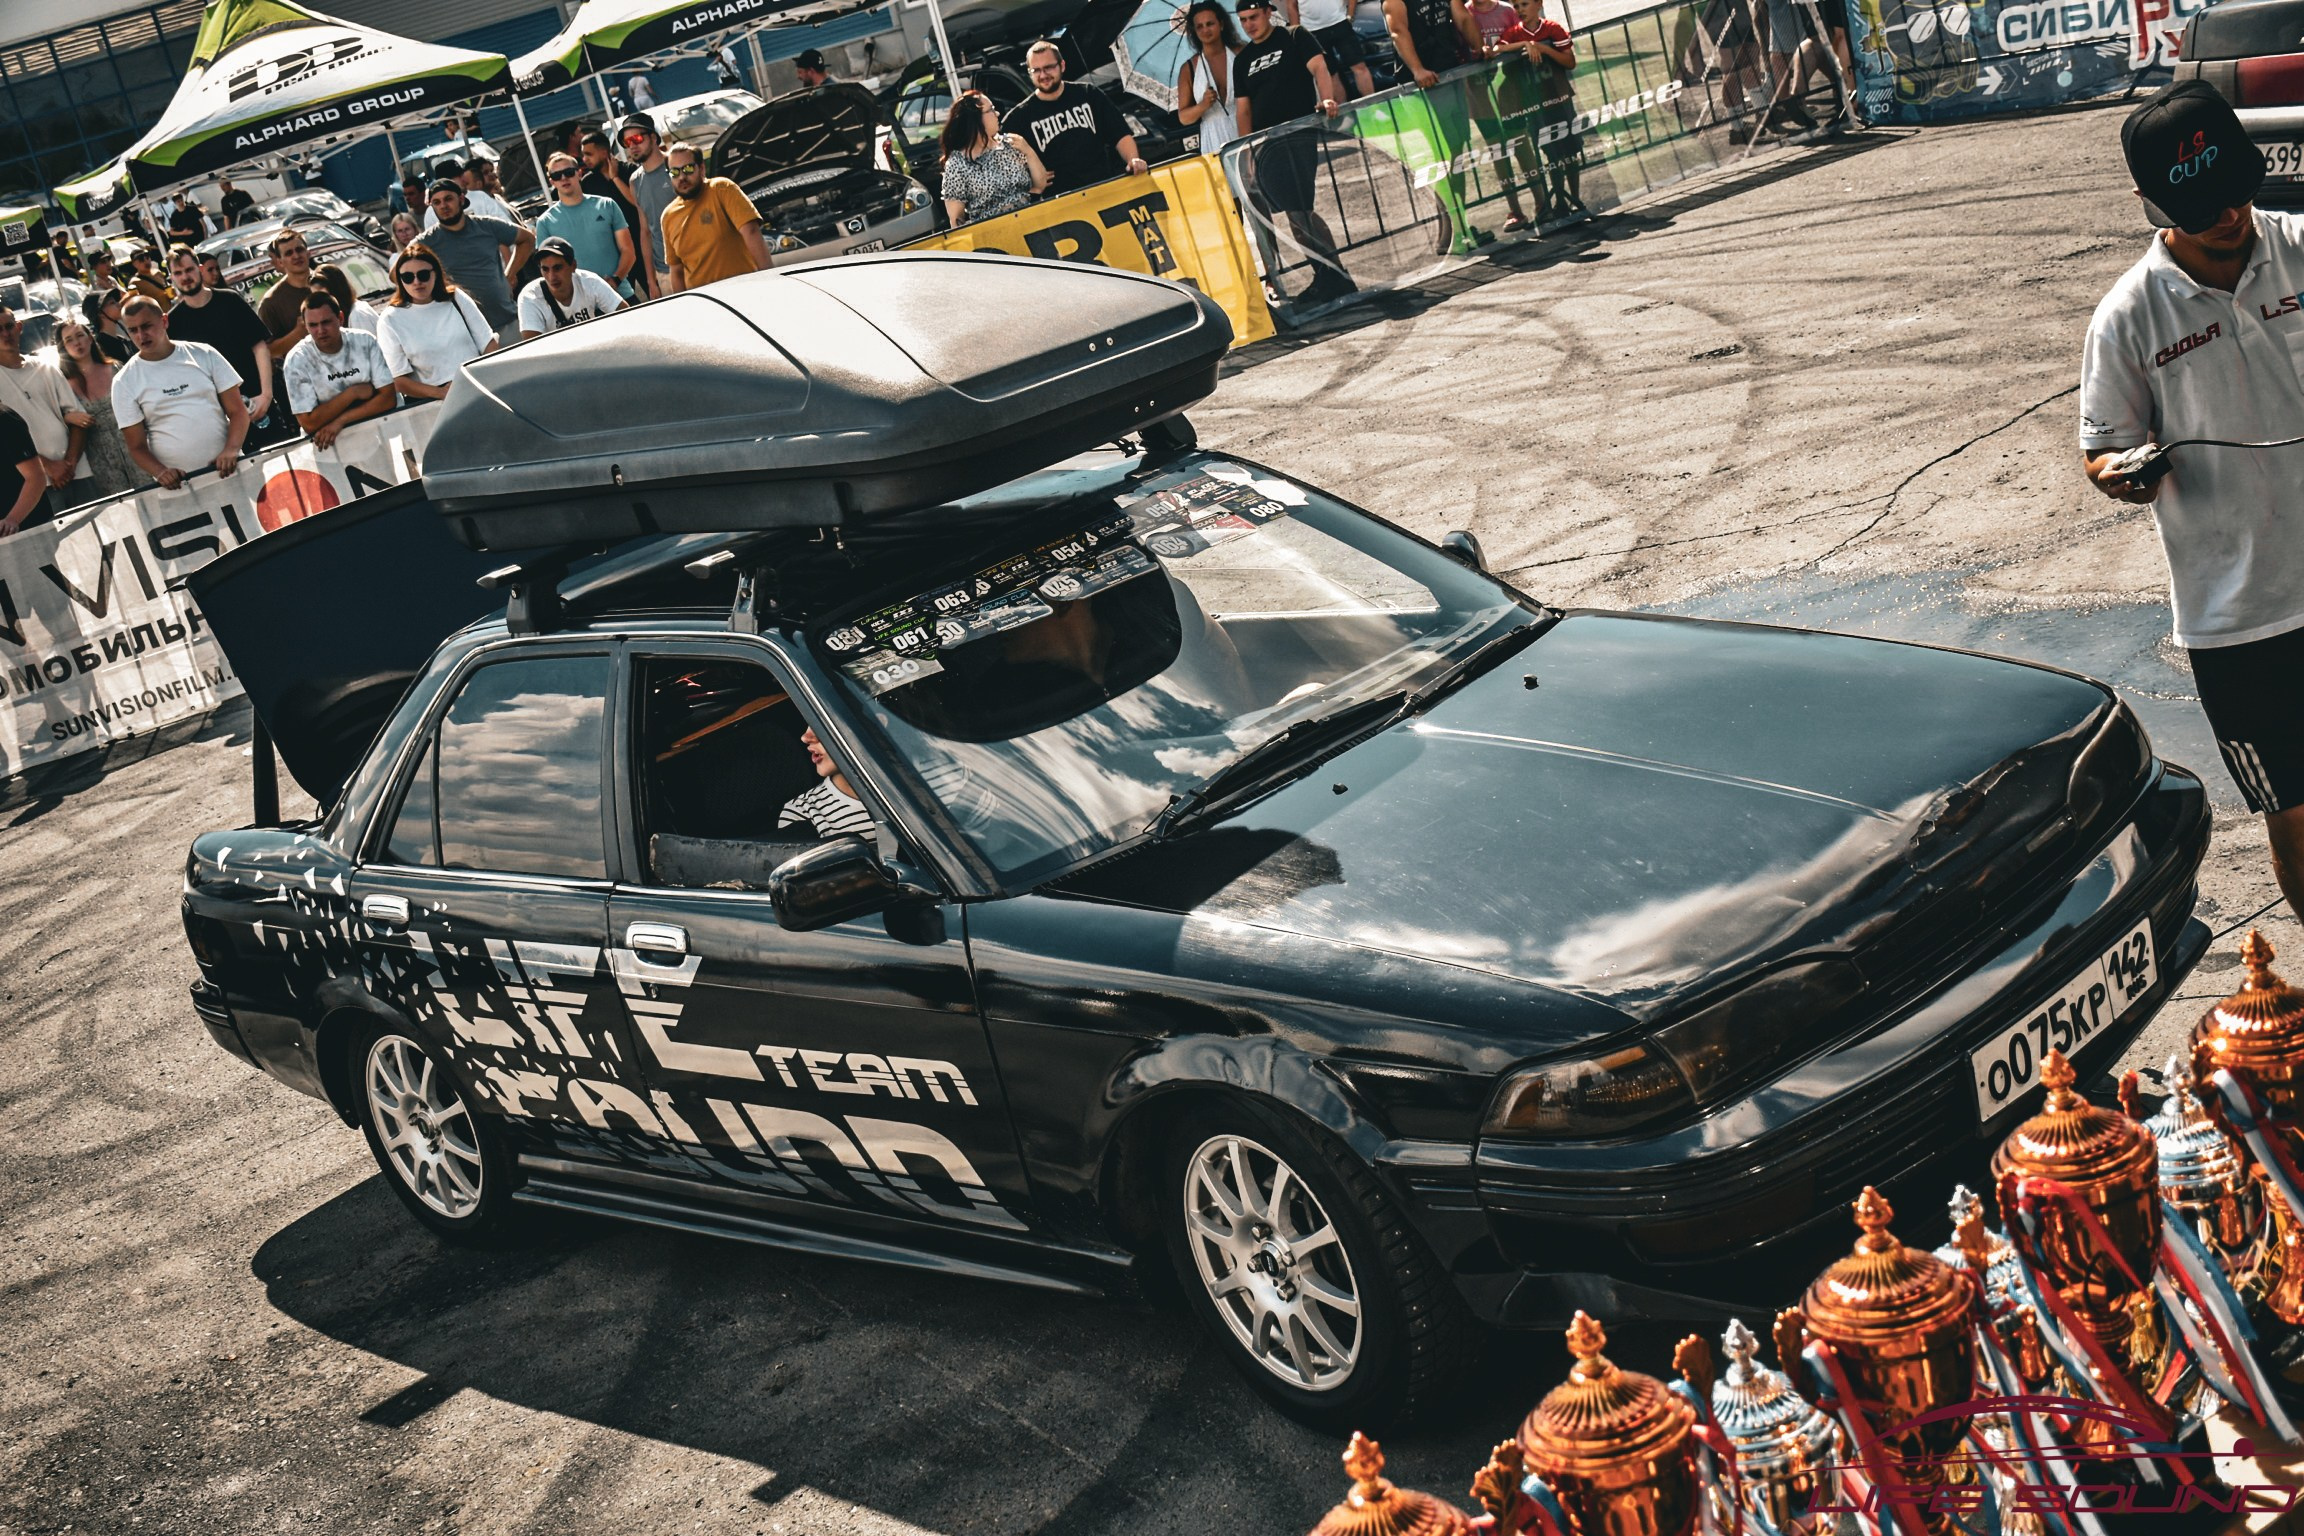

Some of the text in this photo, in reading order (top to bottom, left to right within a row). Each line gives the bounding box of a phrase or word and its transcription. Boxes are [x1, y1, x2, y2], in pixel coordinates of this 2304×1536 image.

[235, 86, 425, 150] ALPHARD GROUP
[1030, 102, 1097, 153] CHICAGO
[1501, 104, 1540, 122] ALPHARD
[2169, 145, 2218, 184] CUP
[2178, 131, 2206, 164] LS
[1128, 205, 1167, 266] MAT
[2154, 321, 2222, 368] СУДЬЯ
[1145, 499, 1177, 519] 050
[1249, 501, 1285, 518] 080
[1050, 541, 1085, 561] 054
[934, 590, 971, 612] 063
[892, 626, 929, 650] 061
[873, 659, 920, 685] 030
[51, 665, 238, 742] SUNVISIONFILM.
[2107, 931, 2150, 990] 142
[755, 1044, 979, 1106] TEAM
